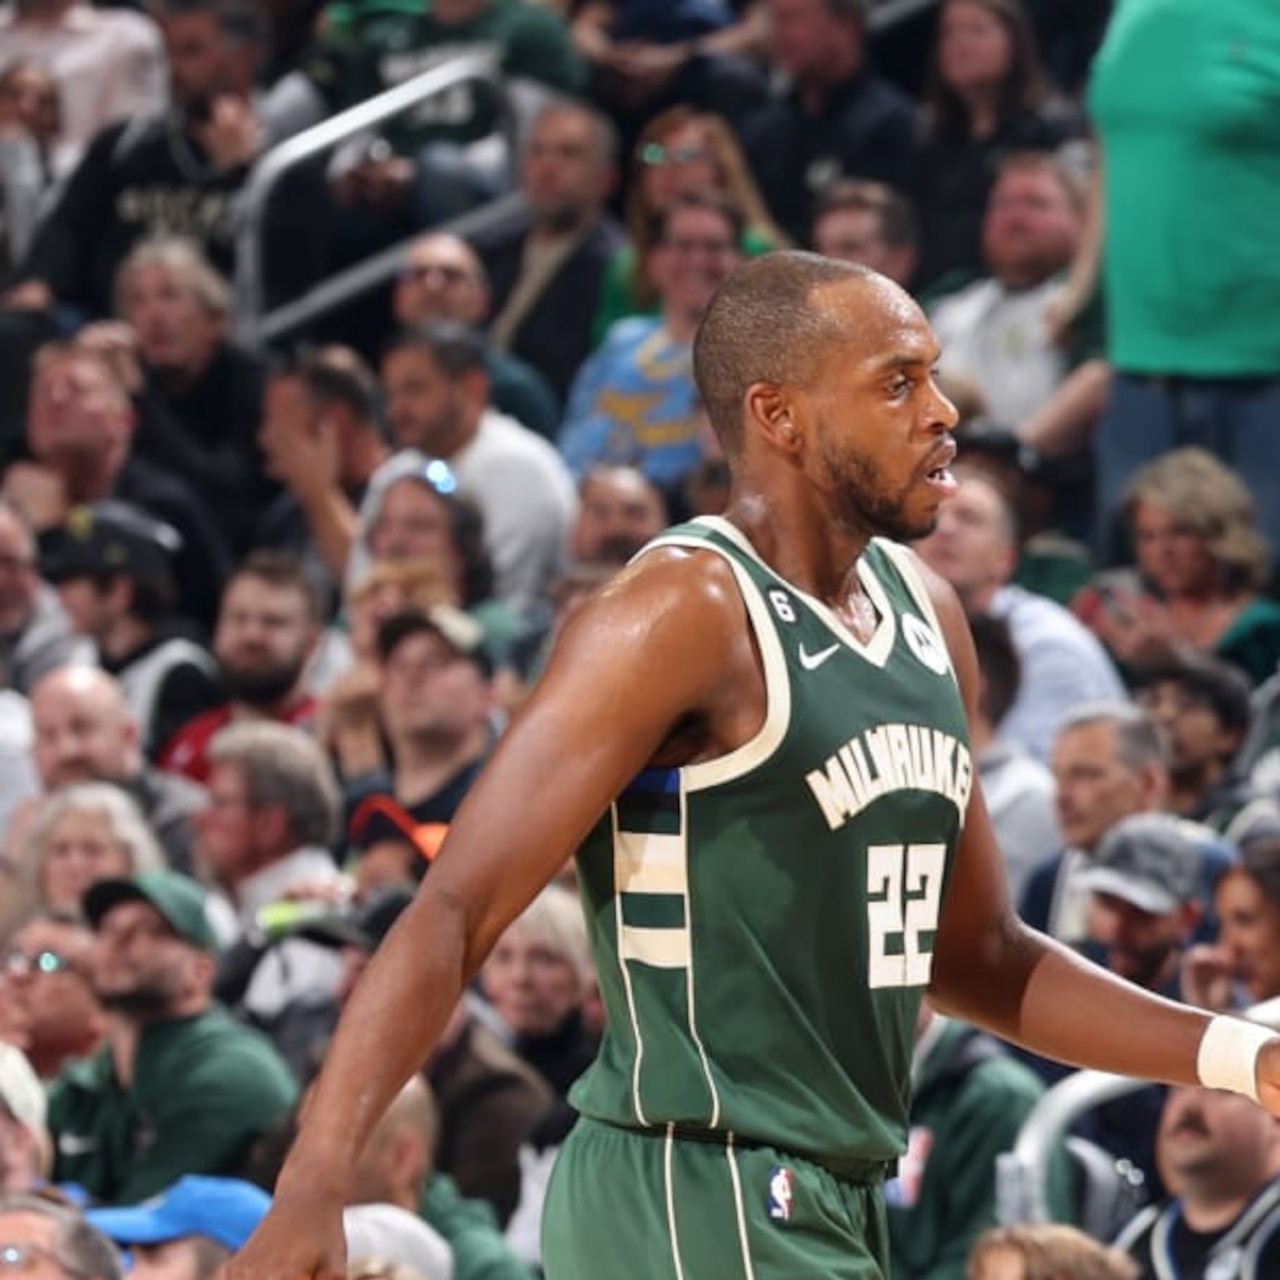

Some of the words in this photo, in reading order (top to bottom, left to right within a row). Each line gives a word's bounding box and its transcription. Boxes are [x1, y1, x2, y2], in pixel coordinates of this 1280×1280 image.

[768, 591, 796, 623] 6
[805, 723, 973, 831] MILWAUKE
[866, 843, 948, 989] 22
